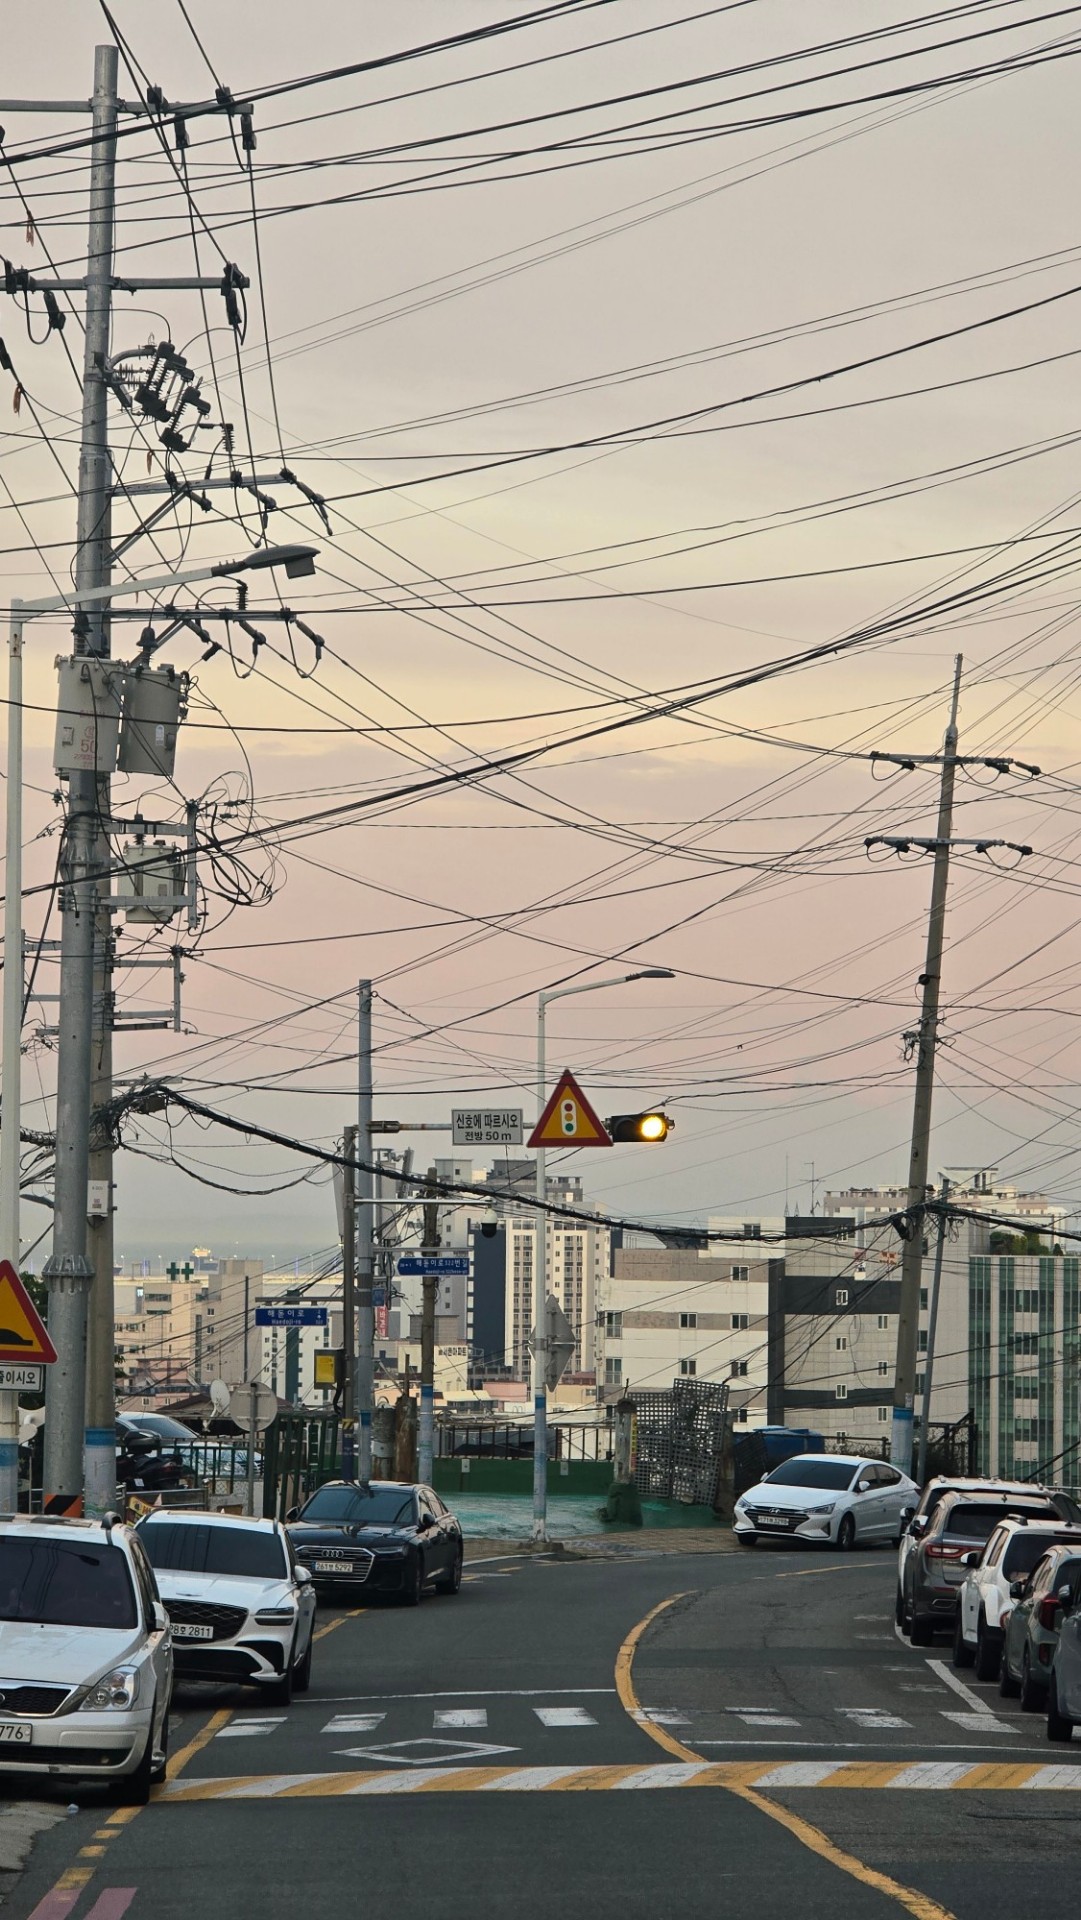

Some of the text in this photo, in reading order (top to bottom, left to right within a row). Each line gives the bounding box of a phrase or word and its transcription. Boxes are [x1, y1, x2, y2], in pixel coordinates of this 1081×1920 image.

[456, 1113, 519, 1129] 신호에 따르시오
[465, 1131, 512, 1141] 전방 50 m
[188, 1626, 210, 1637] 2811
[0, 1725, 24, 1740] 776
